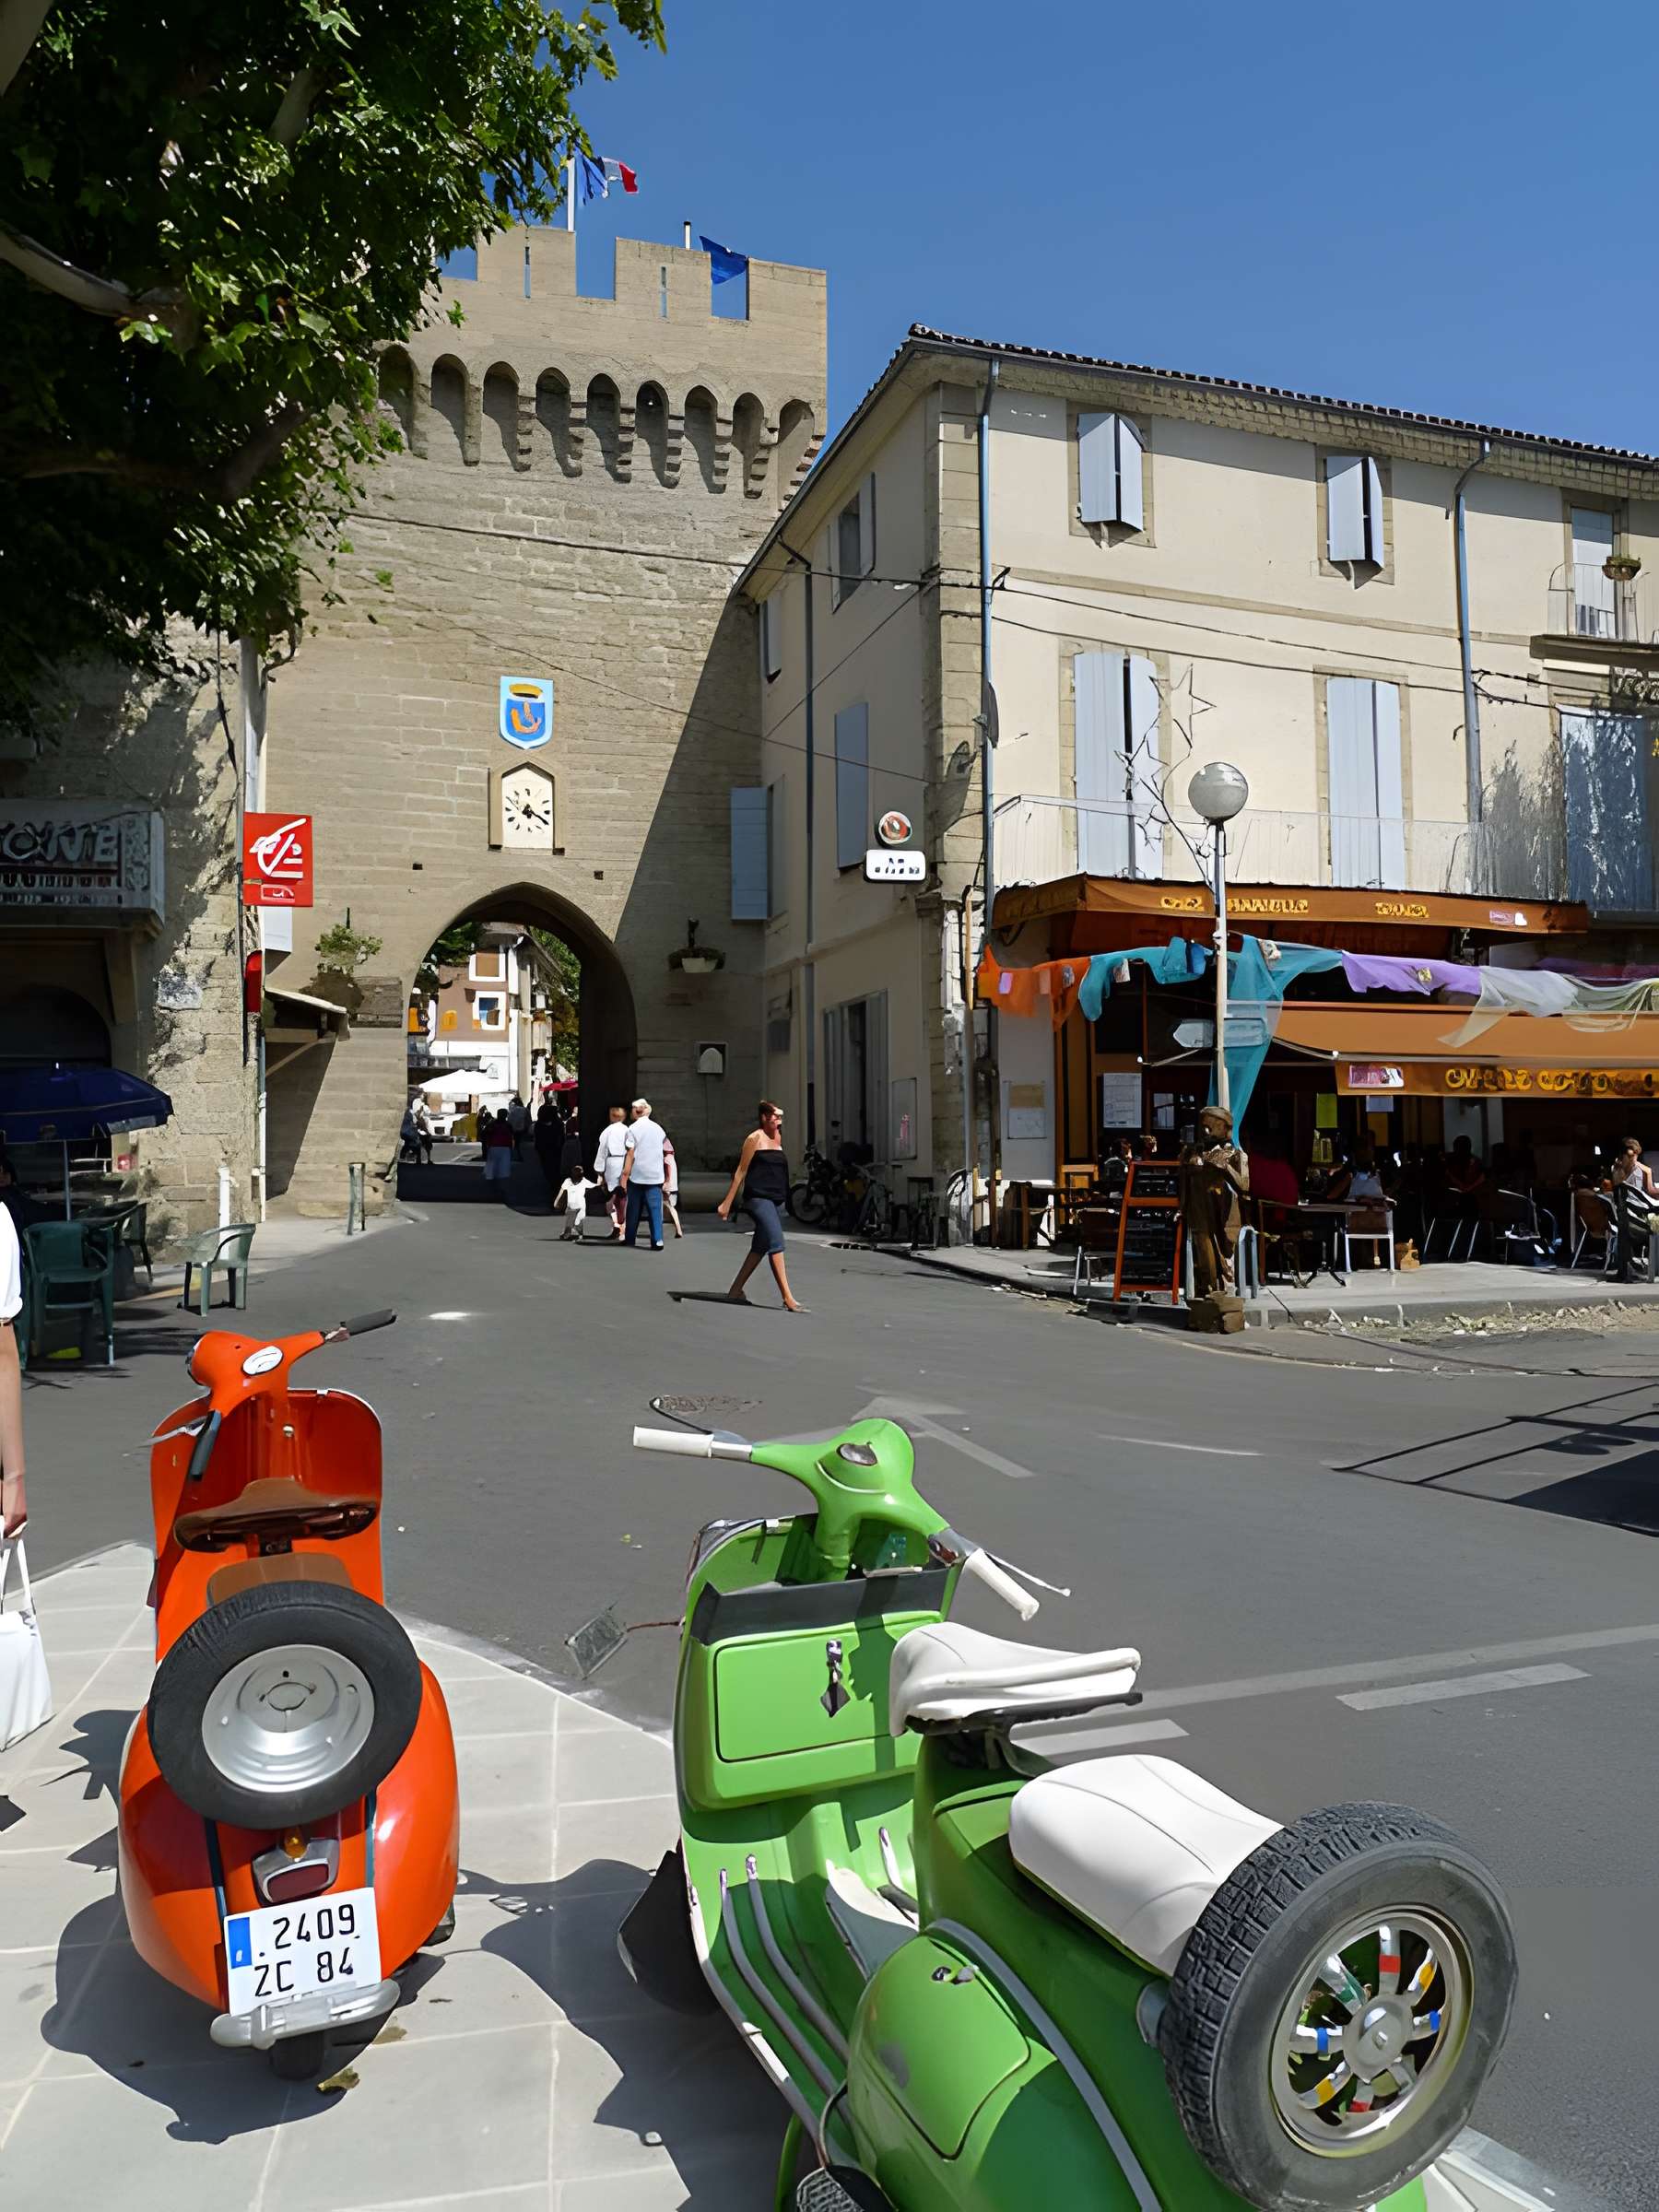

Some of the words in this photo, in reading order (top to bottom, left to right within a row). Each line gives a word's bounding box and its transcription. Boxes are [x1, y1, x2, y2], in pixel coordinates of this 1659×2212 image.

[272, 1903, 357, 1949] 2409
[253, 1959, 295, 1997] ZC
[316, 1947, 354, 1983] 84
